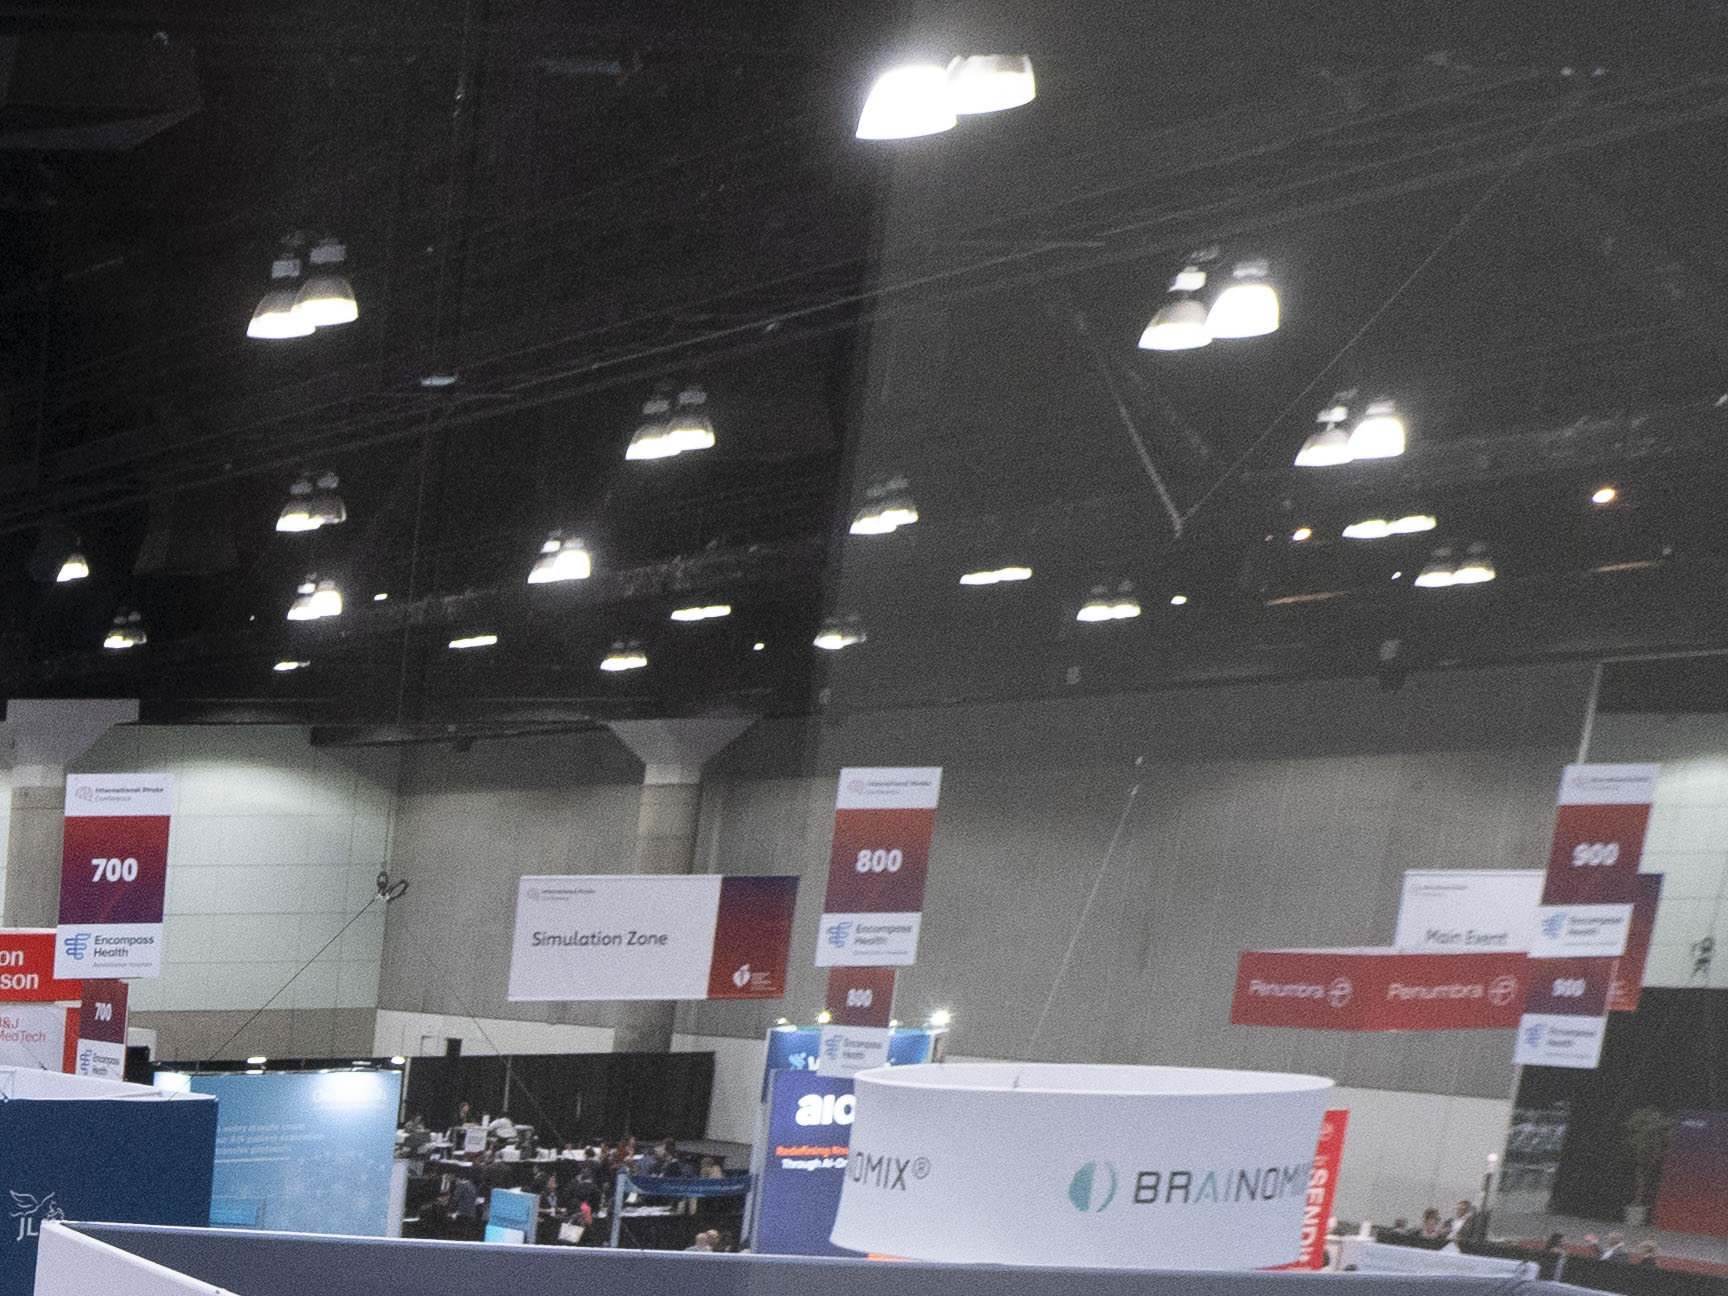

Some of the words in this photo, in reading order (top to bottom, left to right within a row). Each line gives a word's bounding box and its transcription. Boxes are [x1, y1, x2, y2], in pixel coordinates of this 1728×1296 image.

[855, 848, 903, 873] 800
[1570, 843, 1620, 866] 900
[91, 857, 139, 884] 700
[94, 935, 154, 947] Encompass
[532, 929, 622, 947] Simulation
[626, 929, 668, 947] Zone
[93, 947, 129, 958] Health
[1248, 979, 1326, 1000] Penumbra
[1386, 981, 1484, 1001] Penumbra
[93, 1001, 112, 1022] 700
[14, 1215, 40, 1242] JL
